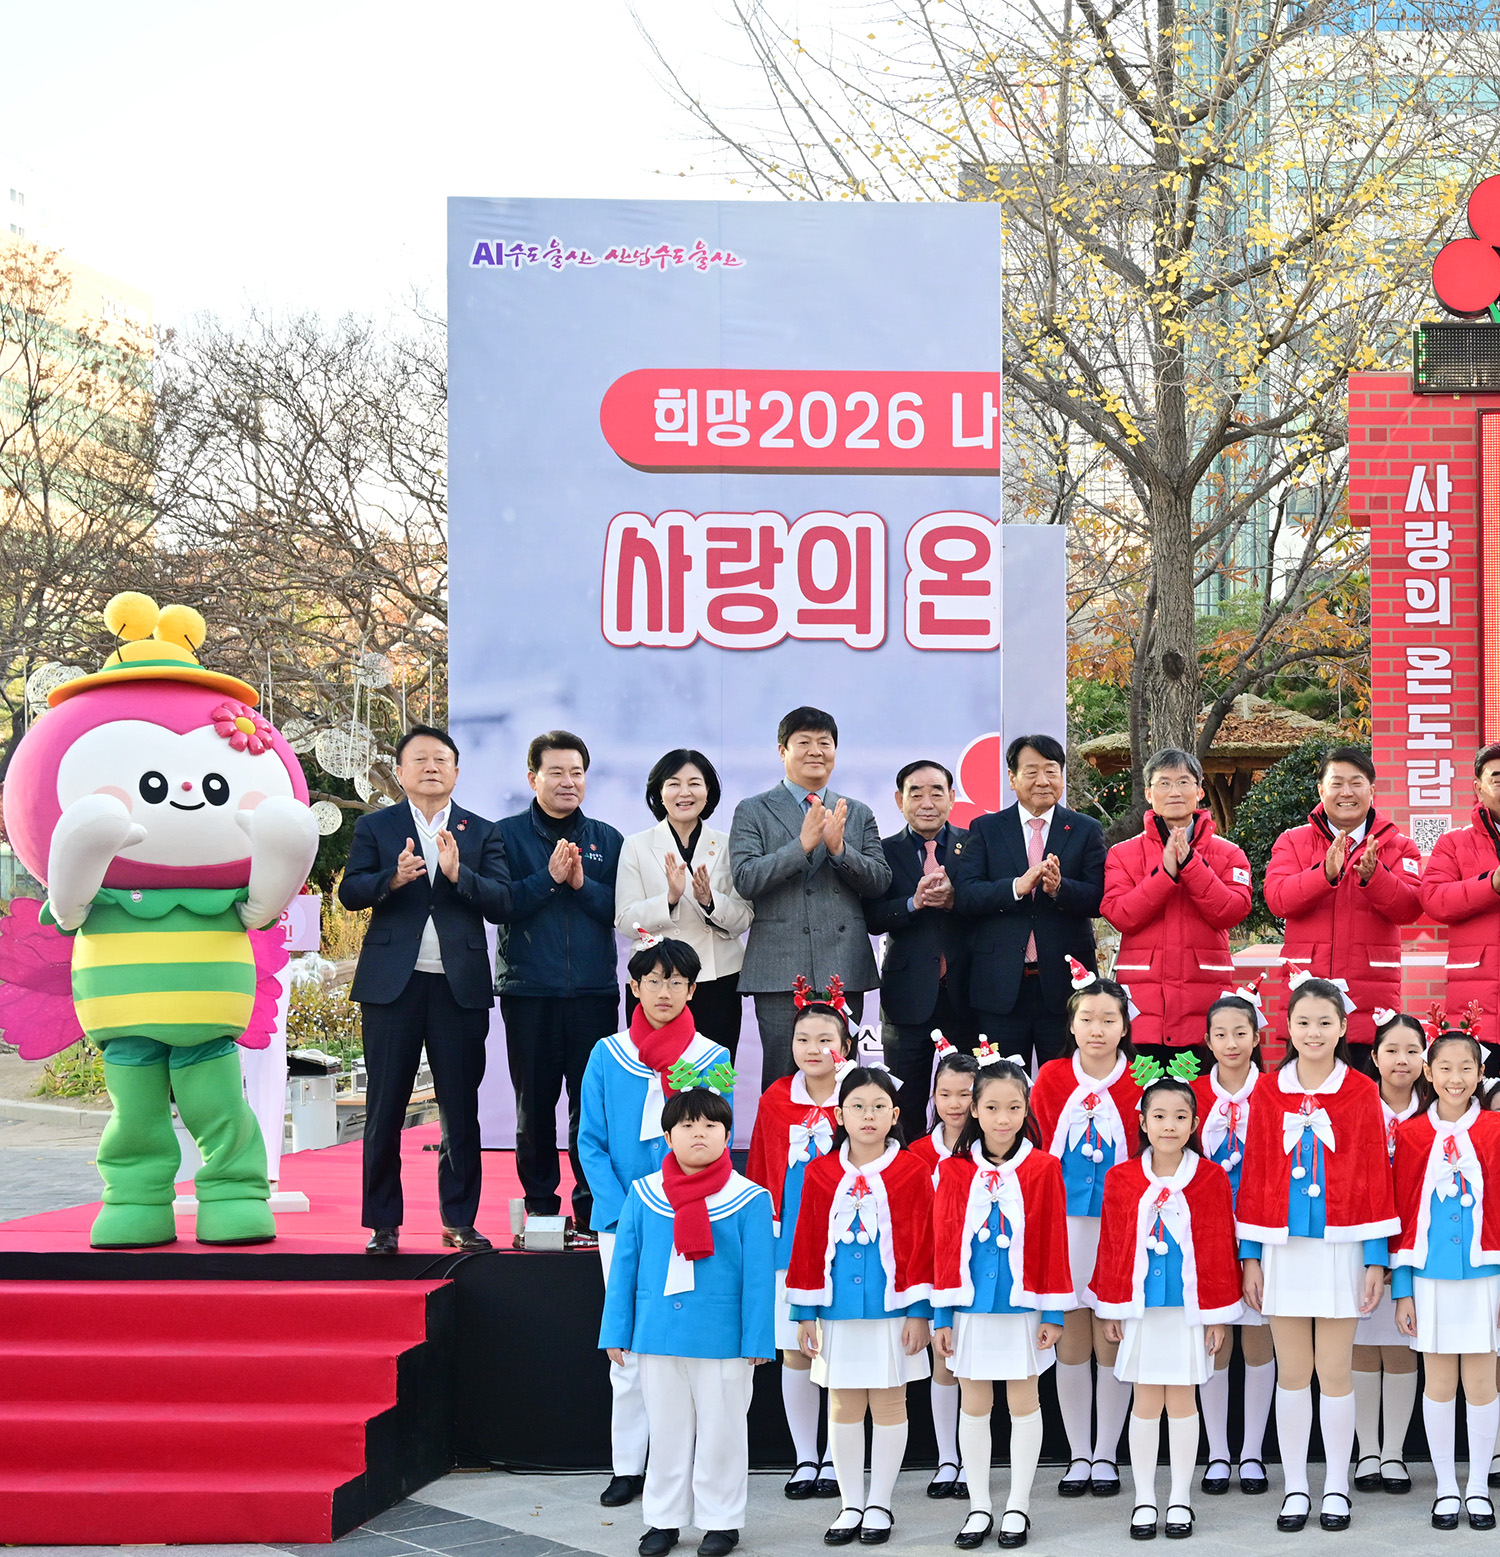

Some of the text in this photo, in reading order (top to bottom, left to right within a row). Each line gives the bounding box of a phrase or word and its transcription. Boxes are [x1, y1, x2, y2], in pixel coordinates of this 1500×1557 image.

[472, 239, 744, 271] AI수도울산 산업수도울산
[653, 388, 925, 449] 희망2026
[611, 521, 995, 640] 사랑의 온
[1404, 464, 1455, 807] 사랑의 온도탑
